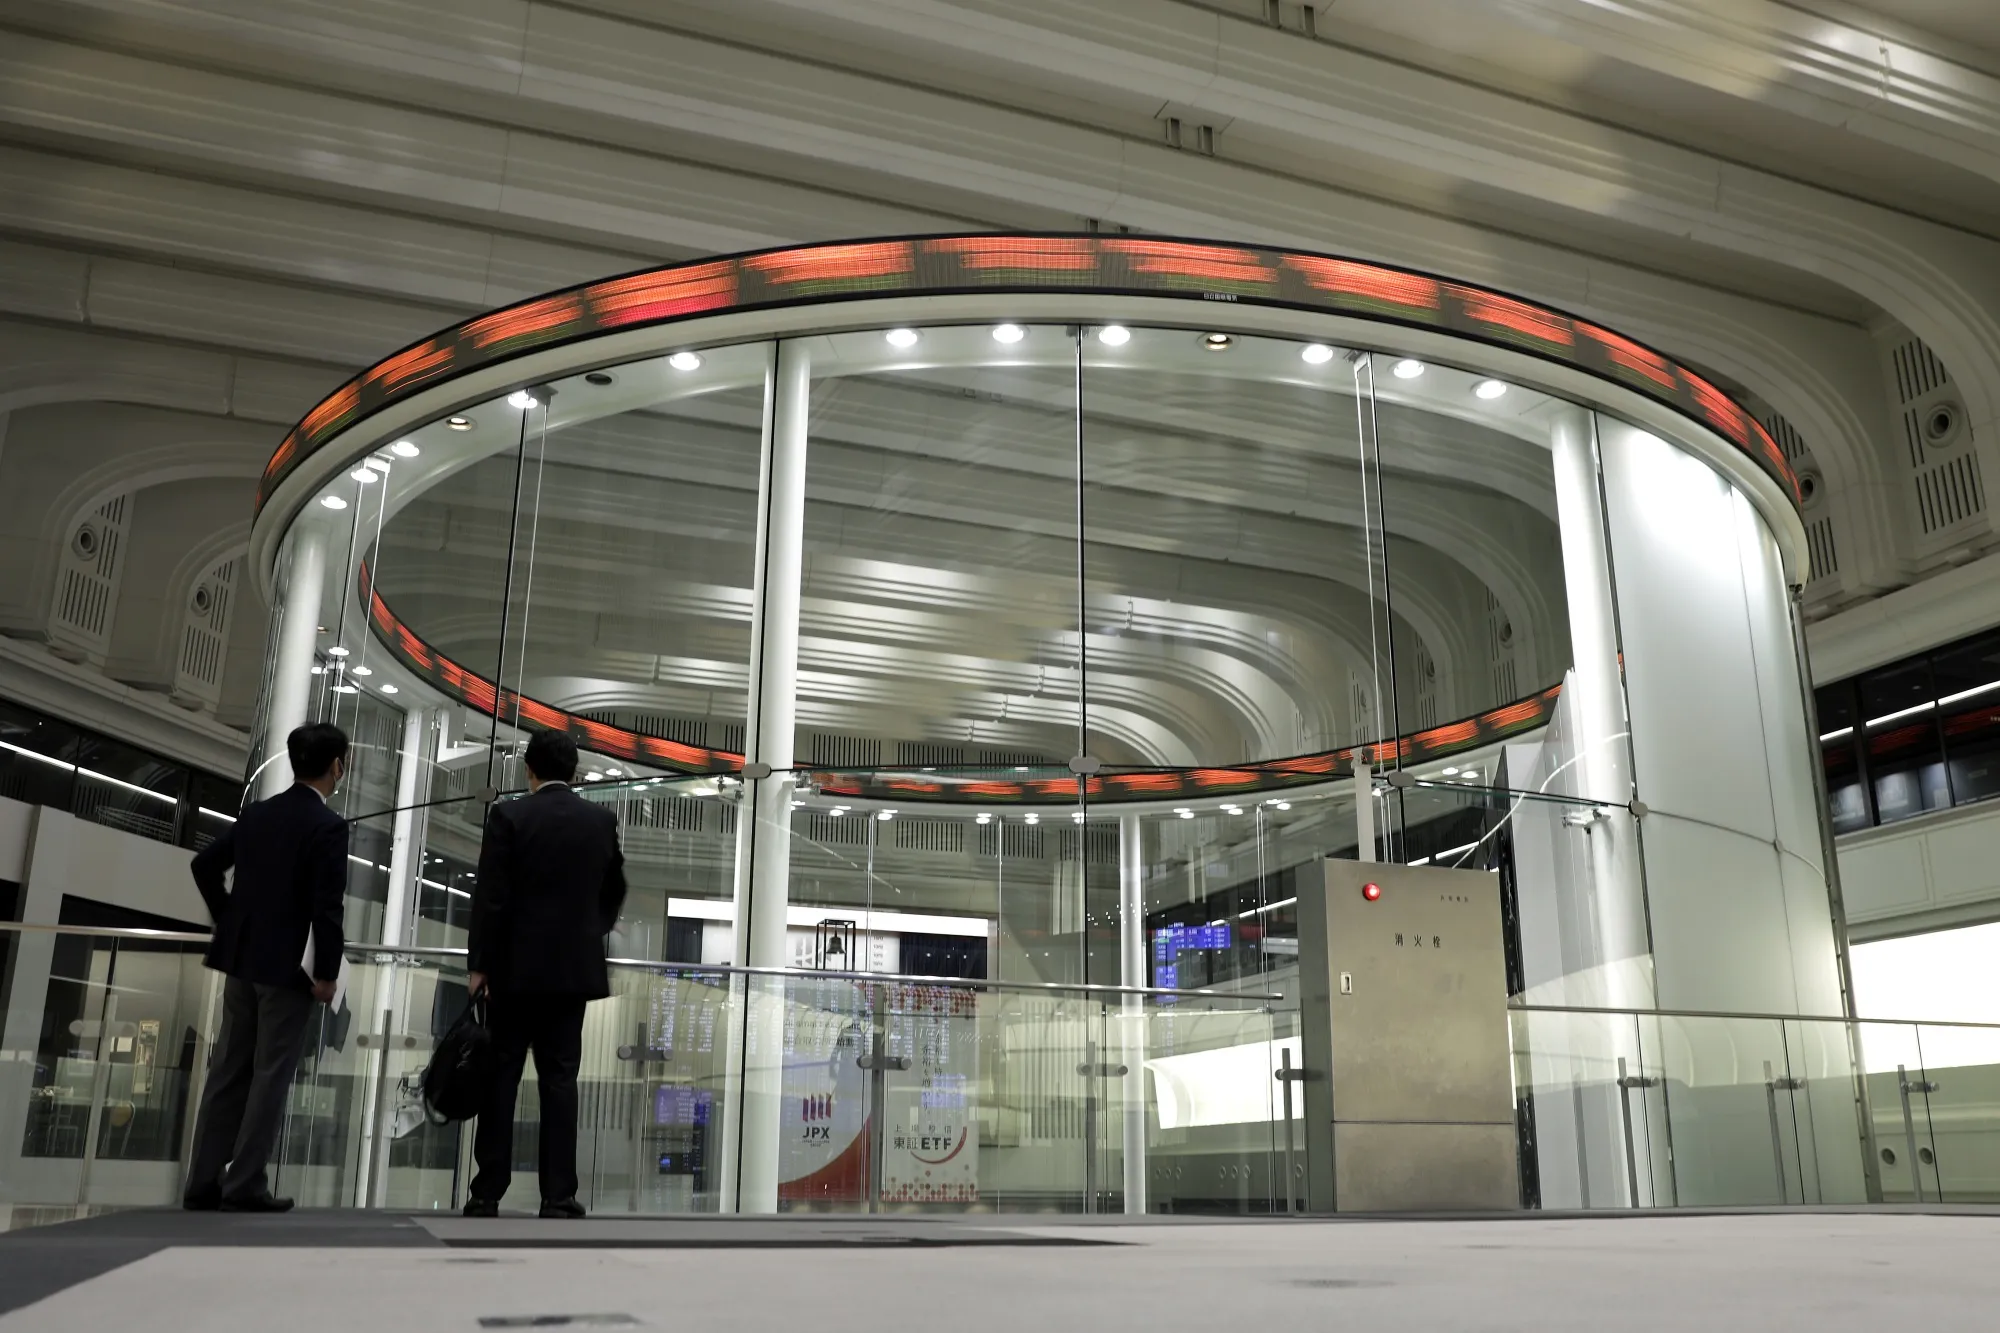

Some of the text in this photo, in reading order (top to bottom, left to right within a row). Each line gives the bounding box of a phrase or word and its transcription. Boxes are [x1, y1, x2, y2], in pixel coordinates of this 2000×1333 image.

[1395, 932, 1441, 948] 消火栓
[802, 1126, 831, 1139] JPX
